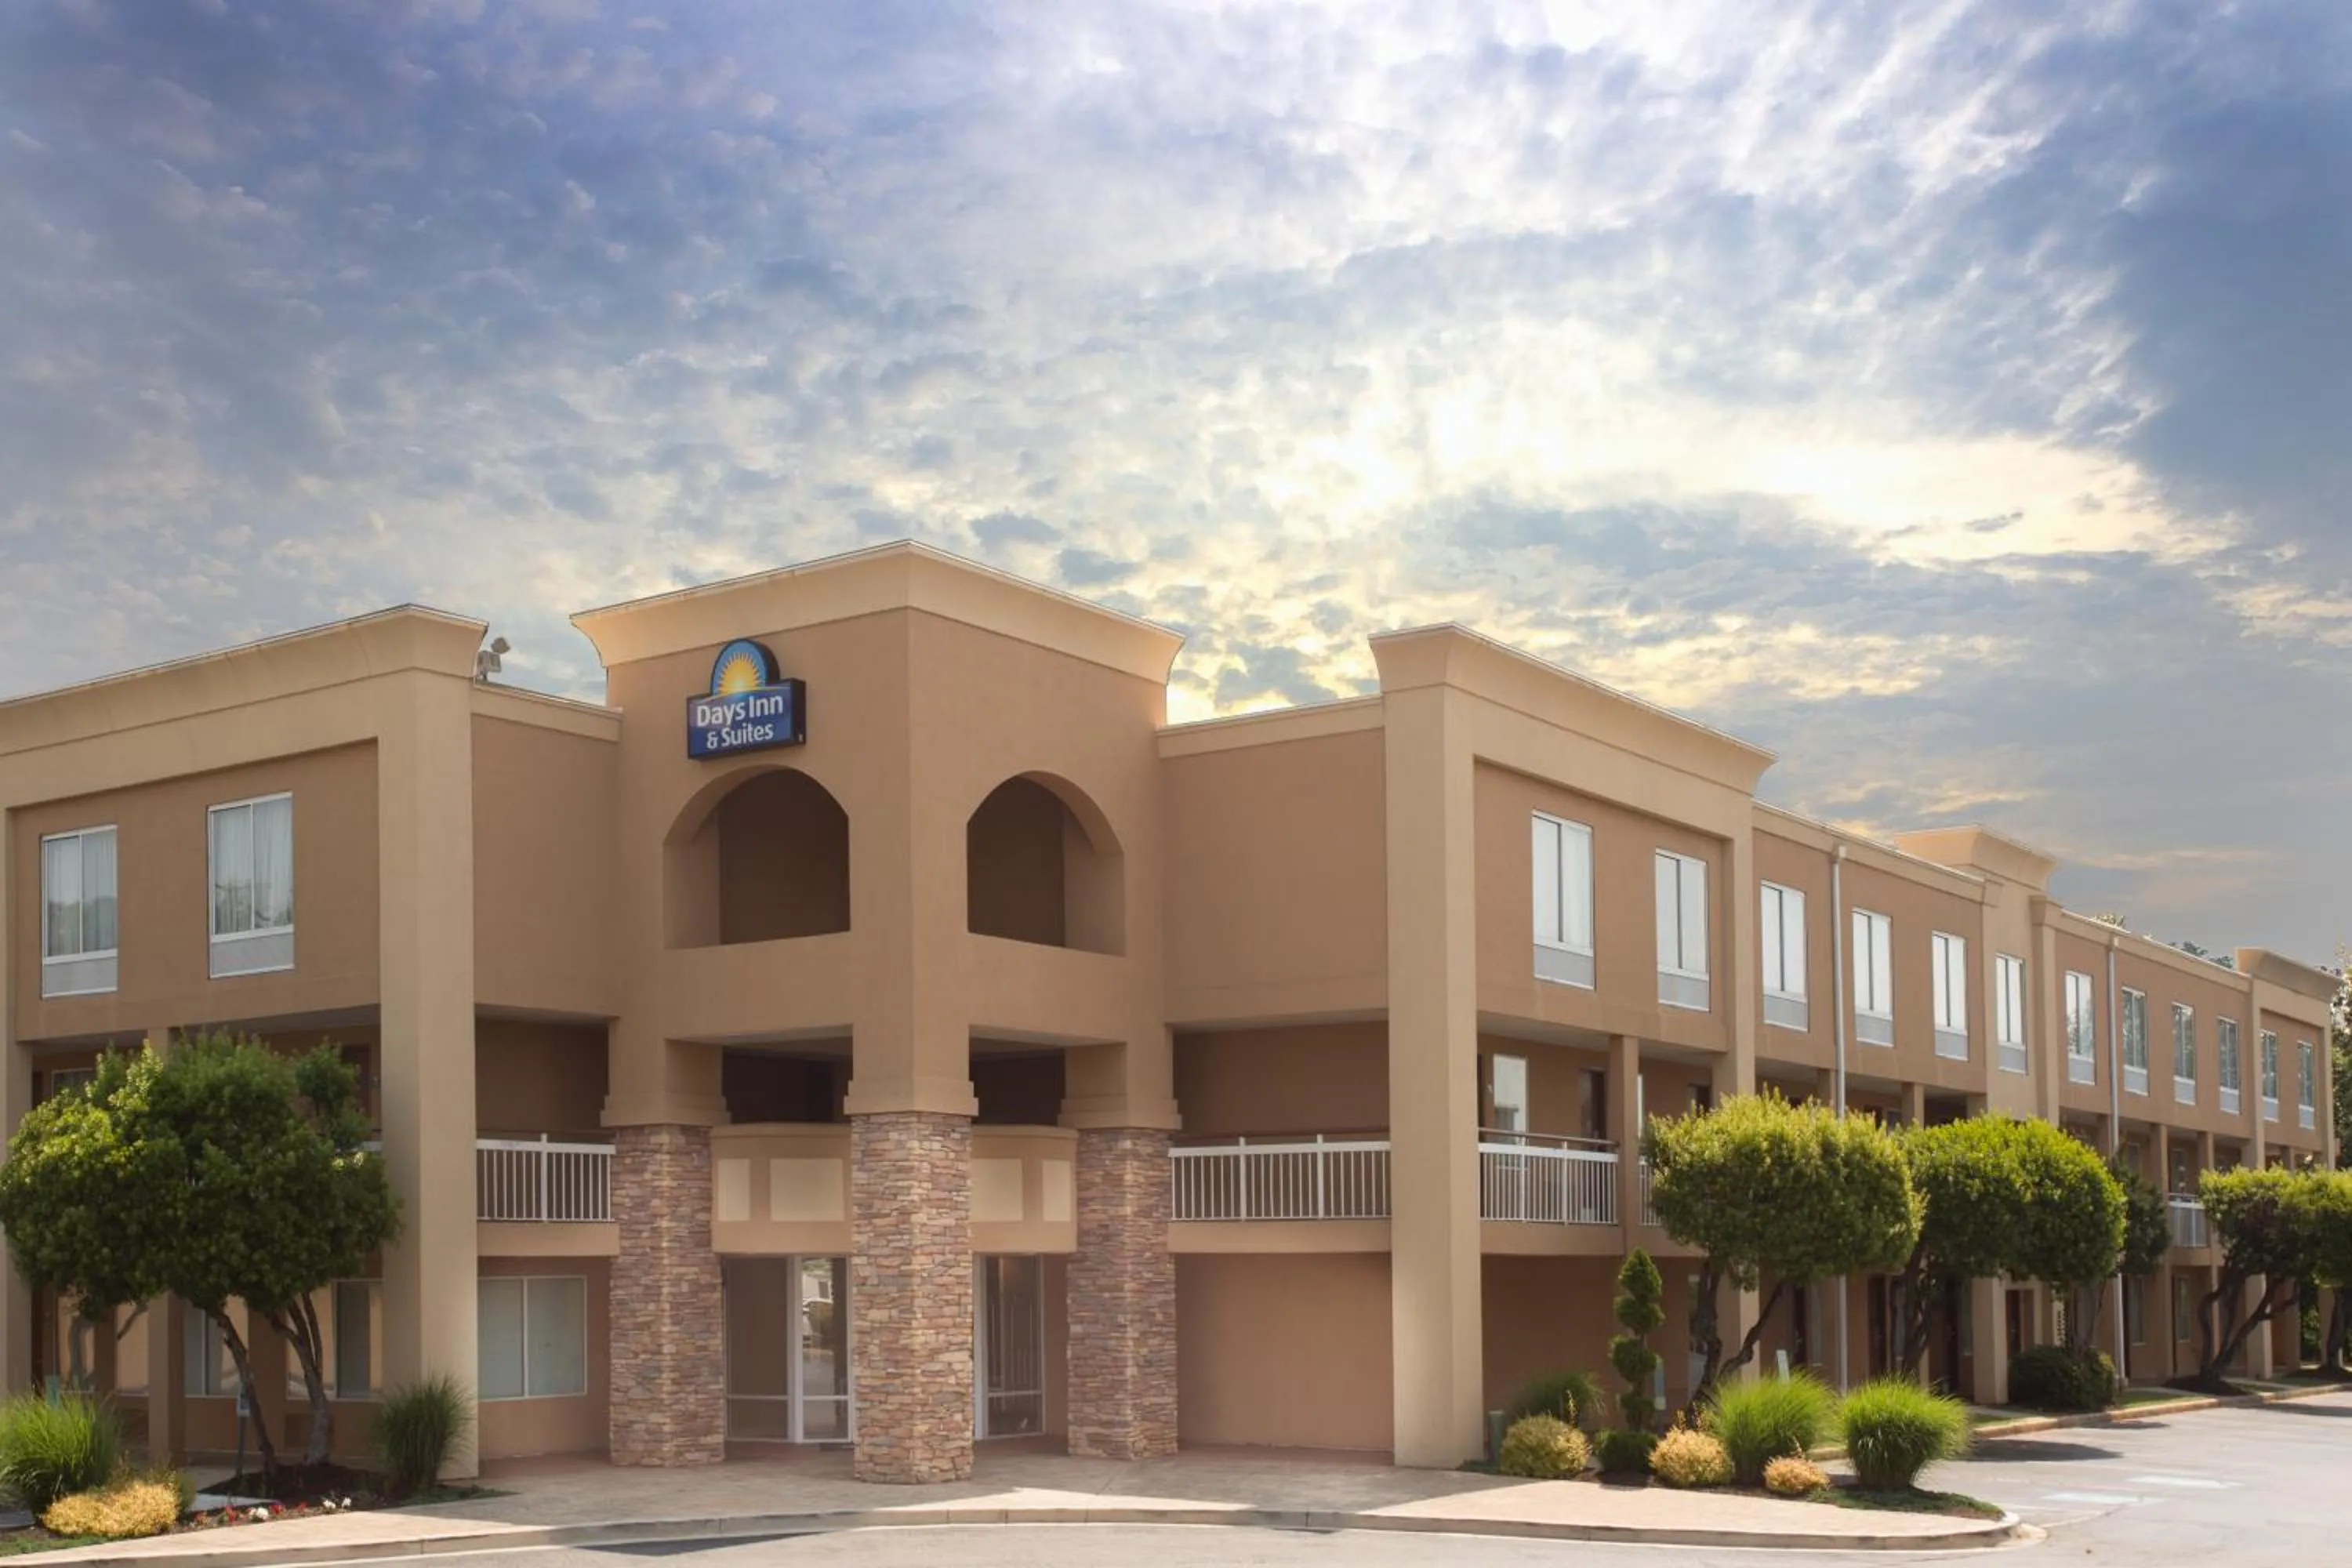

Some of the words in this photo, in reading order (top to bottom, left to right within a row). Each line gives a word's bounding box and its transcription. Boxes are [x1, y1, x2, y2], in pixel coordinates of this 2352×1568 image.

[696, 702, 746, 728] Days
[749, 695, 783, 718] Inn
[706, 731, 718, 750] &
[720, 722, 774, 747] Suites
